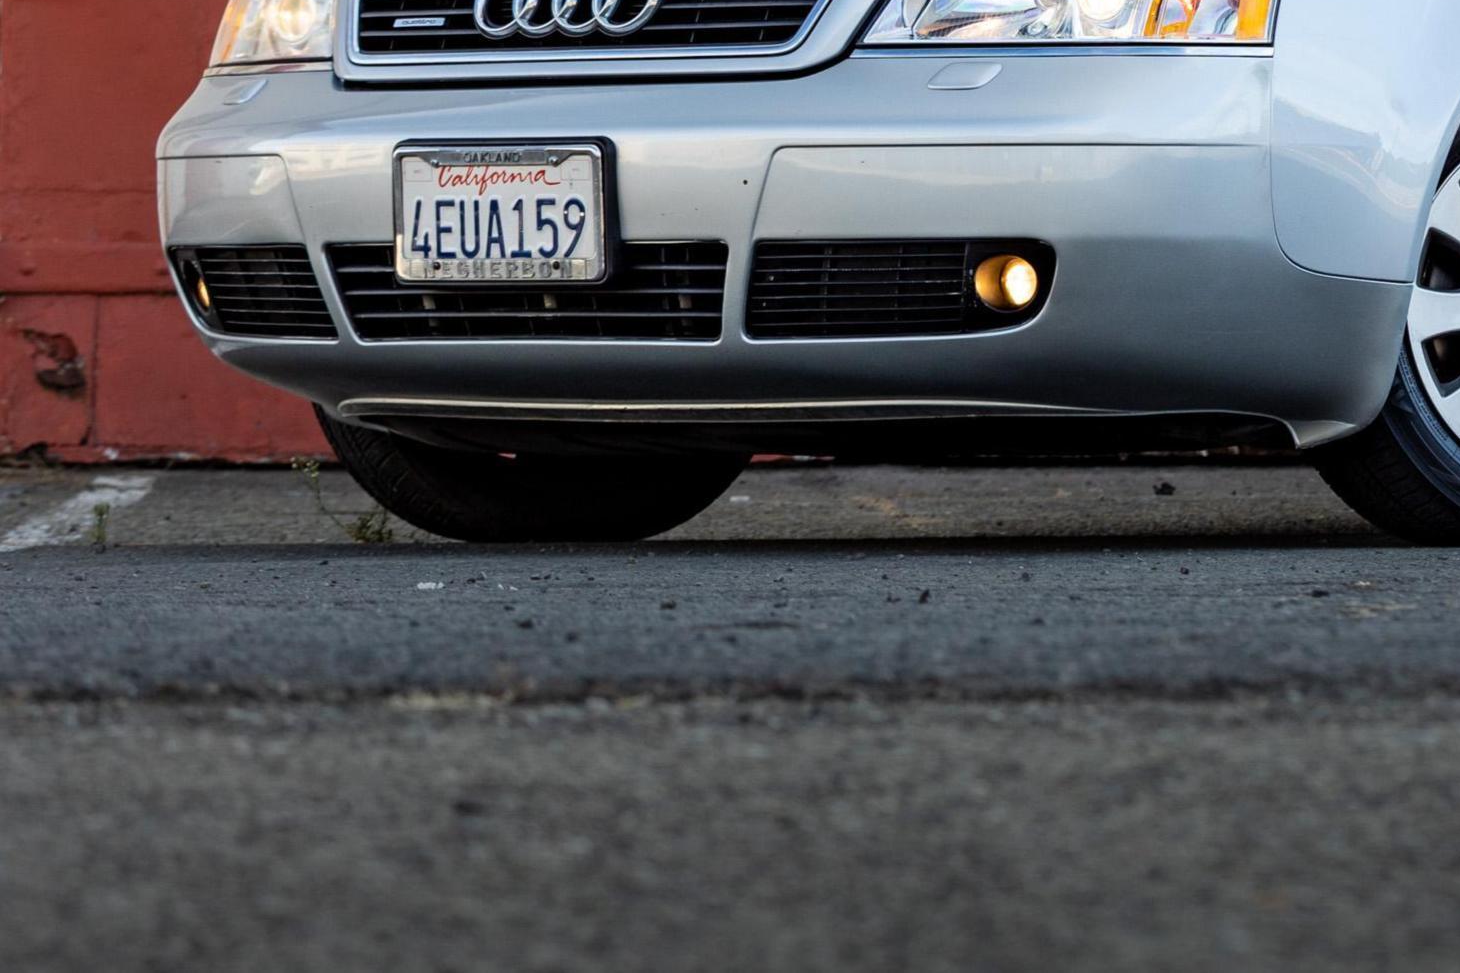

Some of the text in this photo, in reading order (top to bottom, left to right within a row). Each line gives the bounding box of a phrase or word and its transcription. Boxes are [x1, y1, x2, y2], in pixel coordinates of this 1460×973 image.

[462, 151, 522, 164] OAKLAND
[437, 164, 561, 196] California
[410, 197, 586, 259] 4EUA159
